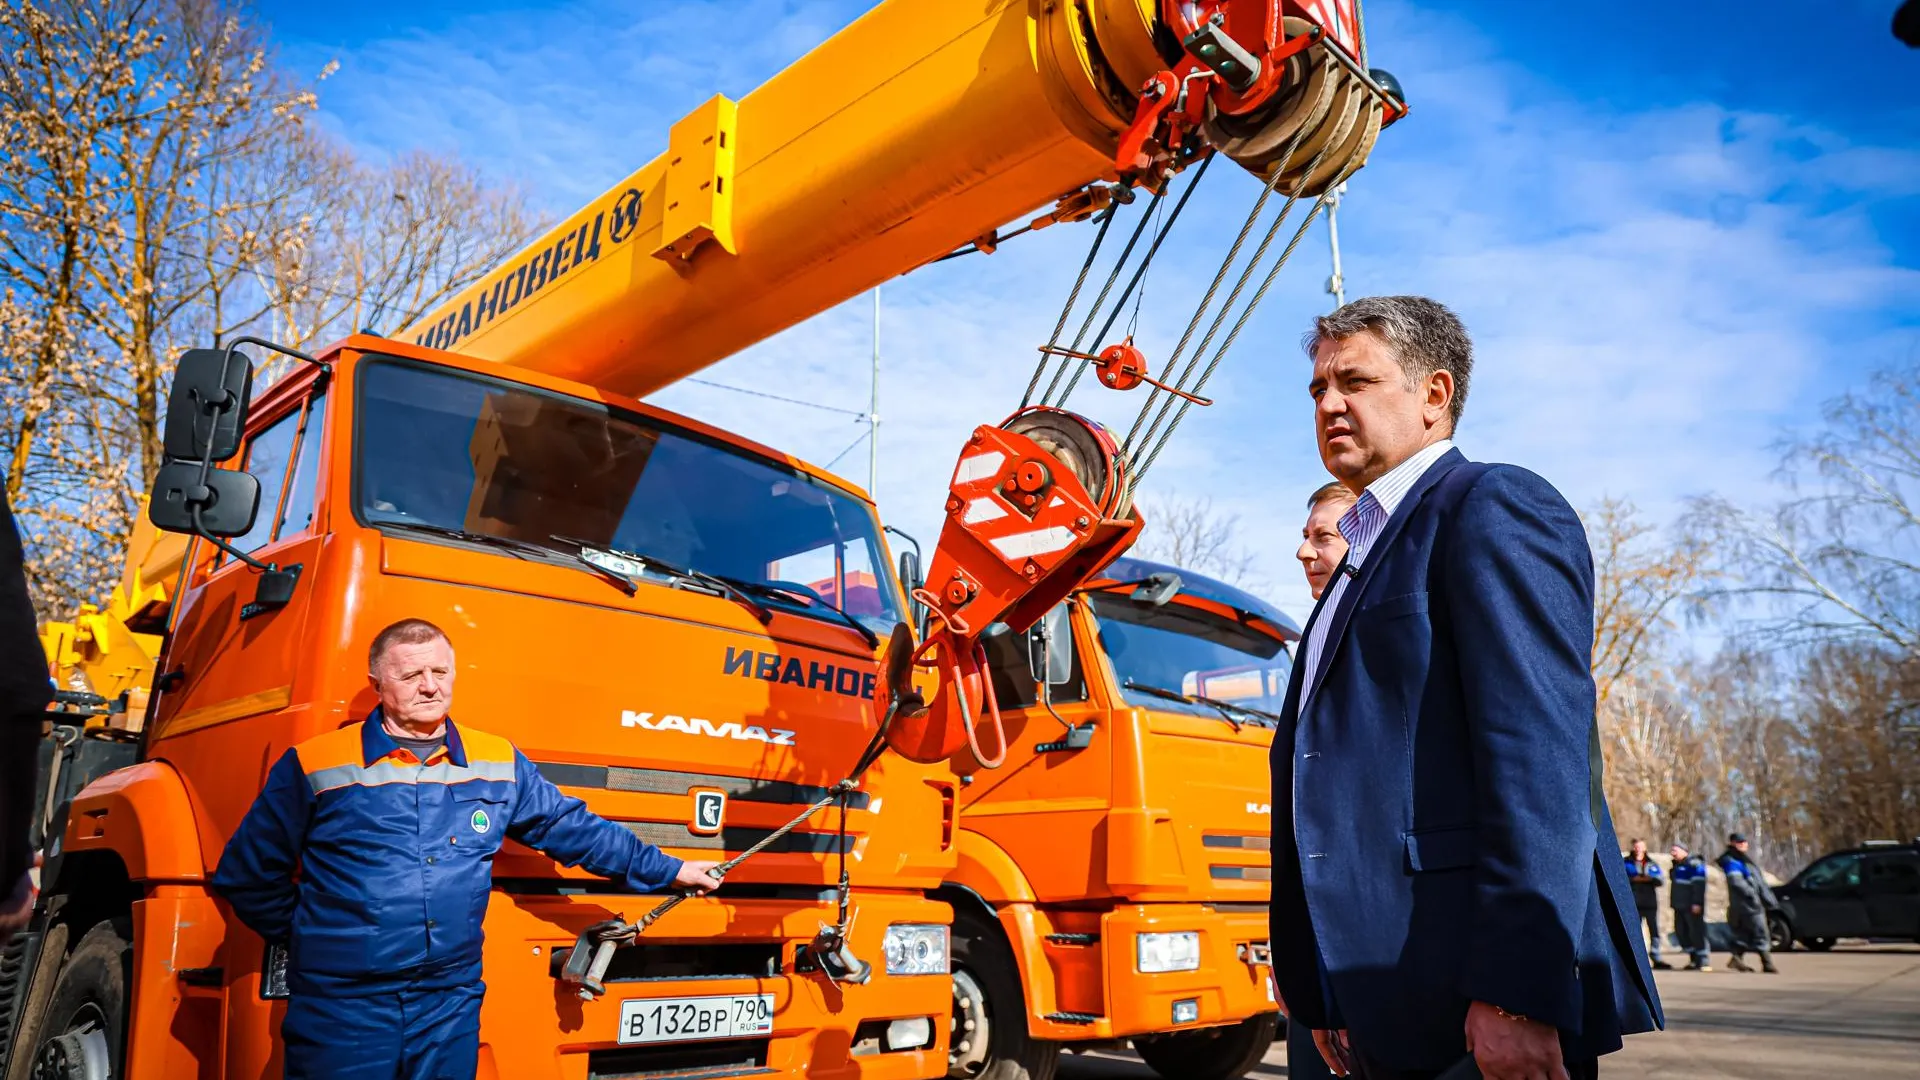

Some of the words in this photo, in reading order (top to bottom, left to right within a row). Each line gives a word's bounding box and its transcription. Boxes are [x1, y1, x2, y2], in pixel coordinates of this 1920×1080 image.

[621, 710, 795, 745] KAMAZ
[735, 1000, 767, 1022] 790
[739, 1022, 757, 1032] RUS
